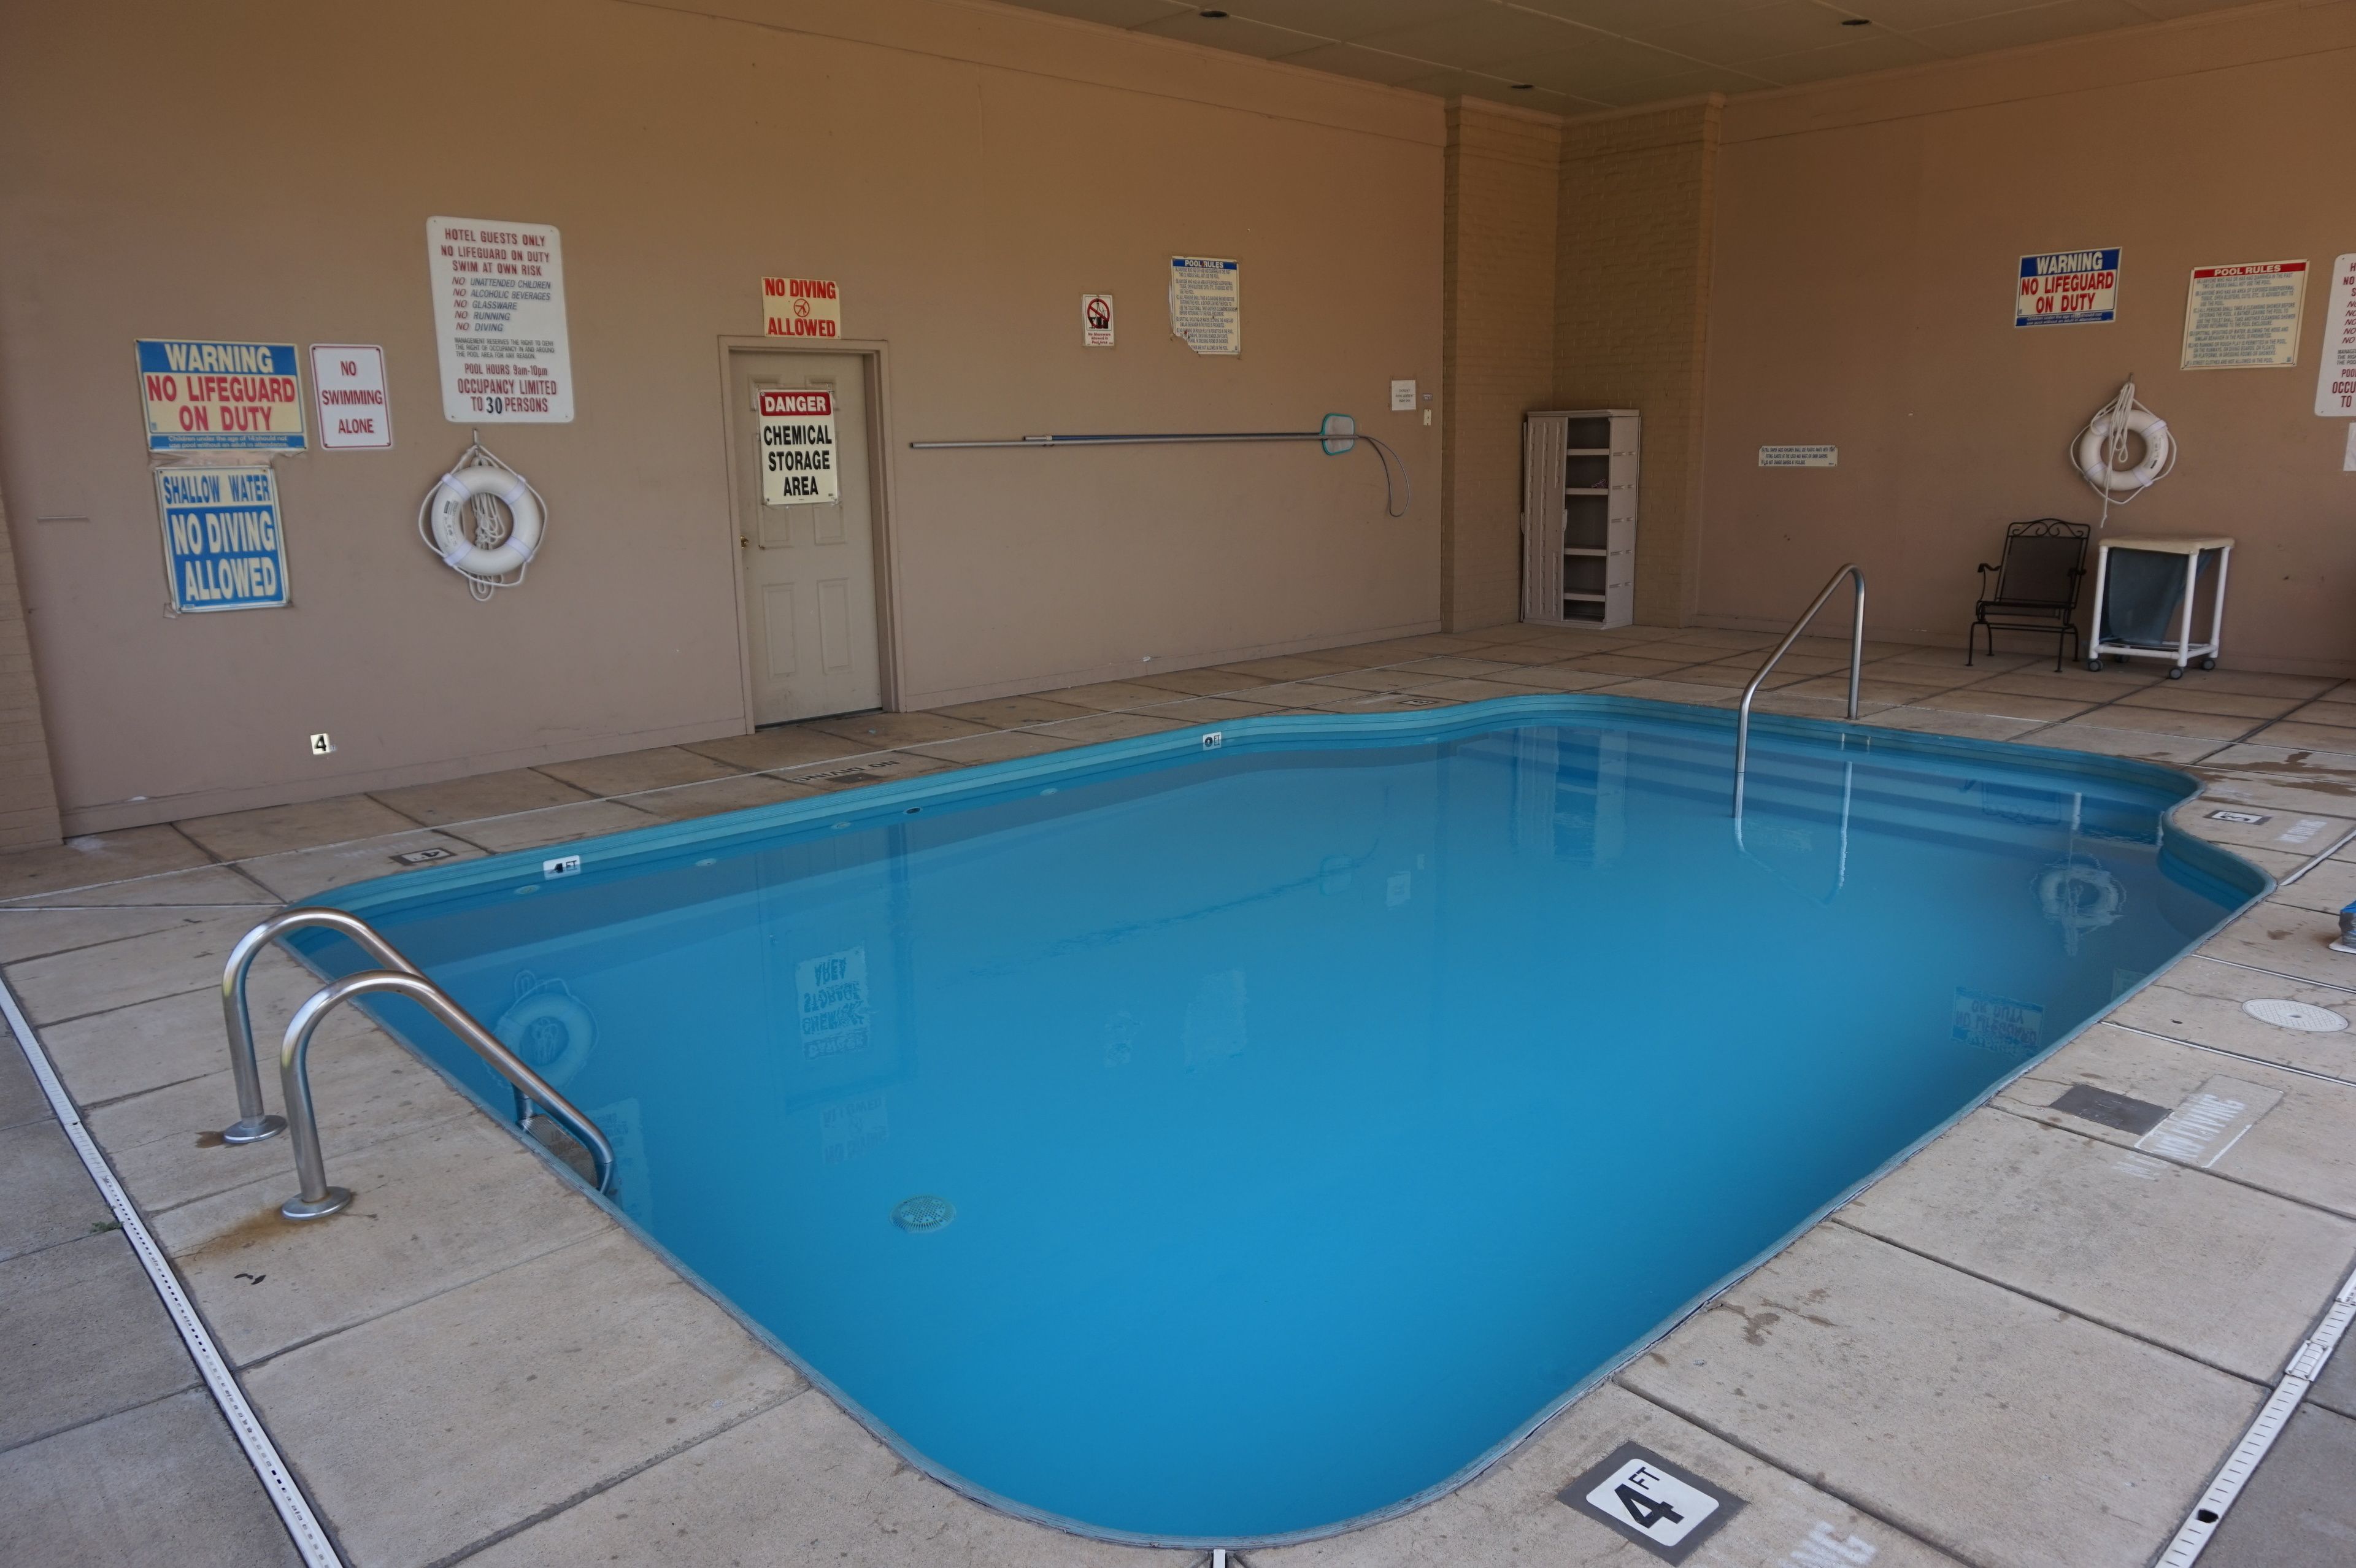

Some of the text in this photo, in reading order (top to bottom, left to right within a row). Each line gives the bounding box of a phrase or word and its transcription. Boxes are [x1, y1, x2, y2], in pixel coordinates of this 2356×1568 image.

[445, 228, 545, 246] HOTEL GUESTS ONLY
[441, 245, 549, 263] NO LIFEGUARD ON DUTY
[453, 260, 542, 275] SWIM AT OWN RISK
[2037, 252, 2103, 275] WARNING
[2246, 264, 2281, 274] RULES
[471, 279, 515, 287] UNATTENDED
[518, 280, 550, 289] CHILDREN
[764, 278, 836, 299] NO DIVING
[2022, 272, 2114, 295] NO LIFEGUARD
[2343, 276, 2355, 285] NO
[471, 290, 509, 299] ALCOHOLIC
[2036, 293, 2096, 313] ON DUTY
[472, 301, 517, 310] GLASSWARE
[473, 312, 510, 320] RUNNING
[768, 317, 836, 337] ALLOWED
[164, 344, 274, 373] WARNING
[341, 361, 356, 376] NO
[465, 363, 547, 377] POOL HOURS 9am-10pm
[147, 375, 295, 402] NO LIFEGUARD
[458, 379, 556, 394] OCCUPANCY LIMITED
[321, 390, 383, 405] SWIMMING
[471, 396, 548, 413] TO 30 PERSONS
[764, 396, 826, 412] DANGER
[2341, 396, 2352, 407] TO
[179, 405, 271, 431] ON DUTY
[339, 418, 374, 434] ALONE
[763, 425, 831, 445] CHEMICAL
[768, 450, 830, 471] STORAGE
[163, 475, 271, 504] SHALLOW WATER
[783, 476, 818, 496] AREA
[171, 510, 275, 555] NO DIVING
[185, 557, 276, 601] ALLOWED
[314, 735, 326, 751] 4
[790, 767, 864, 782] DIVING
[1628, 1466, 1660, 1490] FT
[1614, 1483, 1684, 1529] 4
